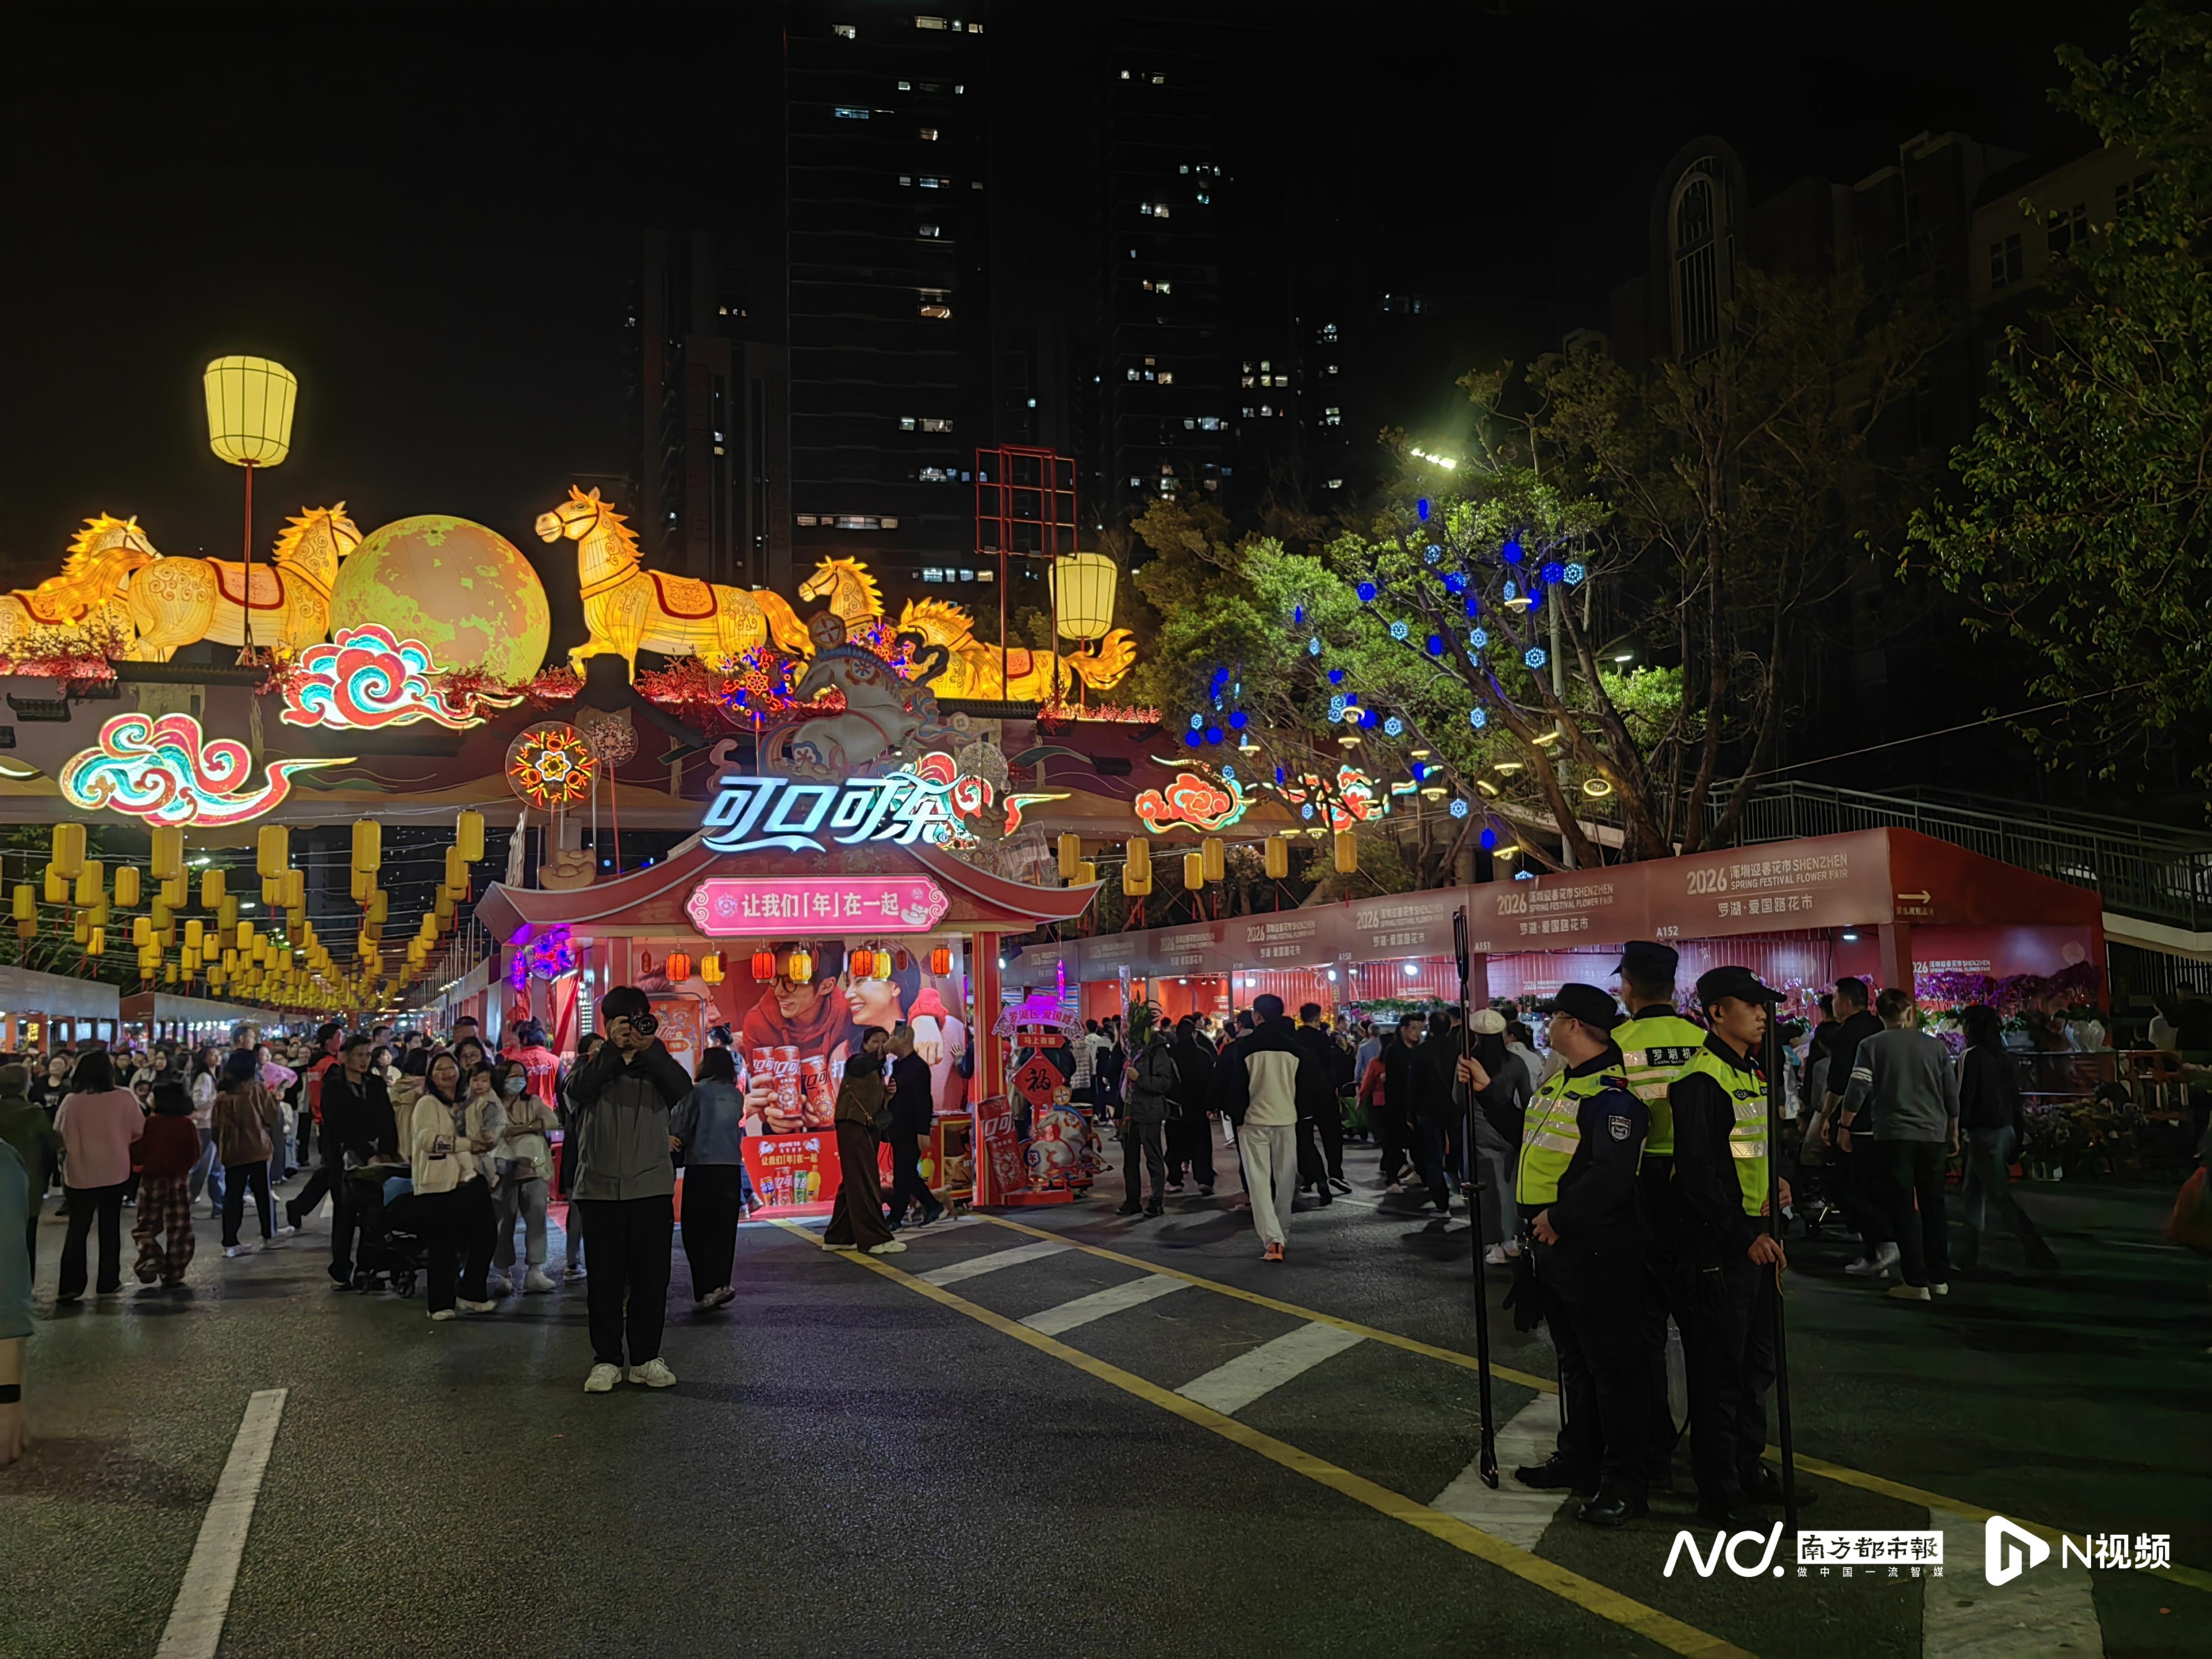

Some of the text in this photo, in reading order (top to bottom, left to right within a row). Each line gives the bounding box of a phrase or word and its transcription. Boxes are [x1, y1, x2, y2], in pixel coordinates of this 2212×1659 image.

[702, 771, 965, 853] 可口可乐
[1687, 853, 1848, 895] 2026 深圳迎春花市 SHENZHEN
[1731, 868, 1849, 891] SPRING FESTIVAL FLOWER FAIR
[741, 892, 899, 917] 让我们「年」在一起
[1496, 893, 1527, 916] 2026
[1574, 884, 1614, 898] SHENZHEN
[1529, 903, 1549, 913] SPRING
[1549, 900, 1575, 911] FESTIVAL
[1576, 898, 1599, 908] FLOWER
[1717, 894, 1813, 918] 罗湖·爱国路花市
[1356, 910, 1379, 930] 2026
[1656, 926, 1678, 938] A152
[1474, 941, 1491, 951] A151
[1009, 1009, 1072, 1025] 罗湖区 爱国路
[1025, 1068, 1051, 1092] 福
